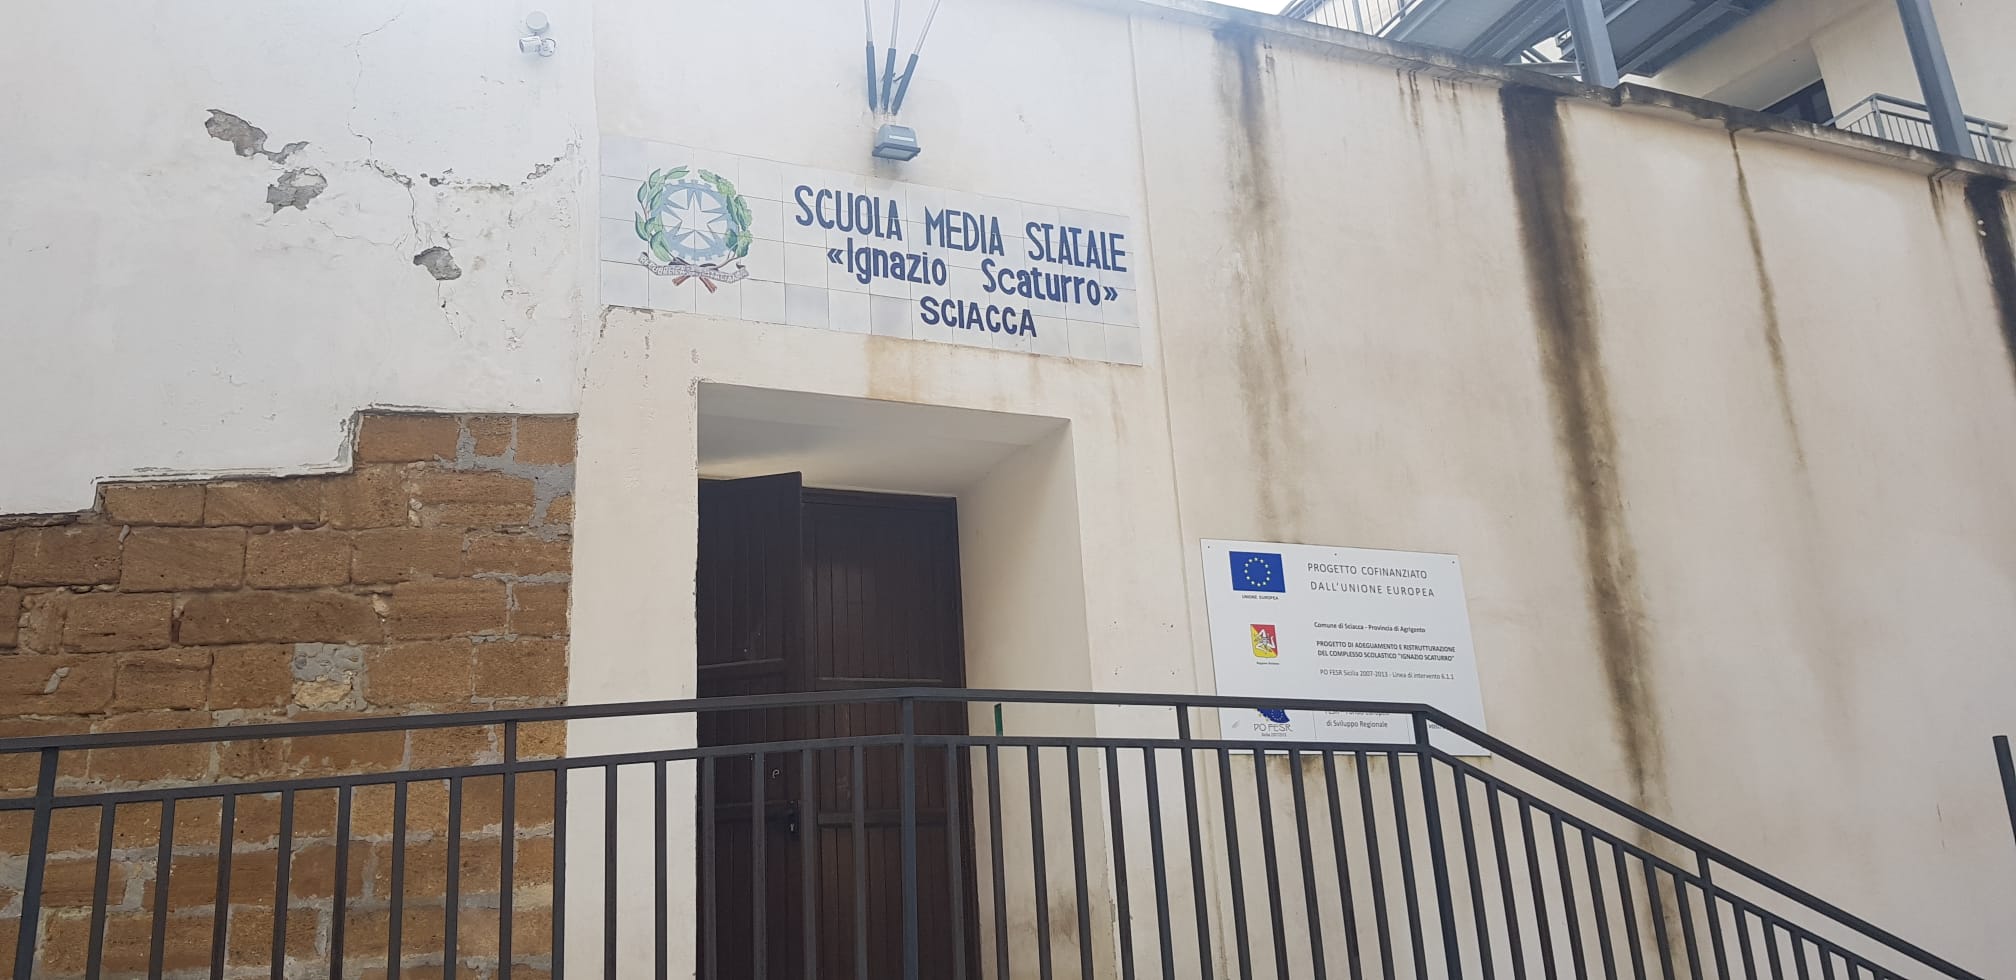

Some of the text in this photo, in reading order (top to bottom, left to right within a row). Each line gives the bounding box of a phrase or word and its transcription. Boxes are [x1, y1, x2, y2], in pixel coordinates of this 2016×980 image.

[794, 184, 1127, 273] SCUOLA MEDIA STATALE
[826, 237, 1118, 306] «Ignazio Scaturro»
[920, 296, 1037, 337] SCIACCA
[1307, 562, 1427, 579] PROGETTO COFINANZIATO
[1310, 581, 1434, 597] DALL'UNIONE EUROPEA
[1253, 723, 1293, 732] PO FESR
[1333, 720, 1359, 728] Sviluppo
